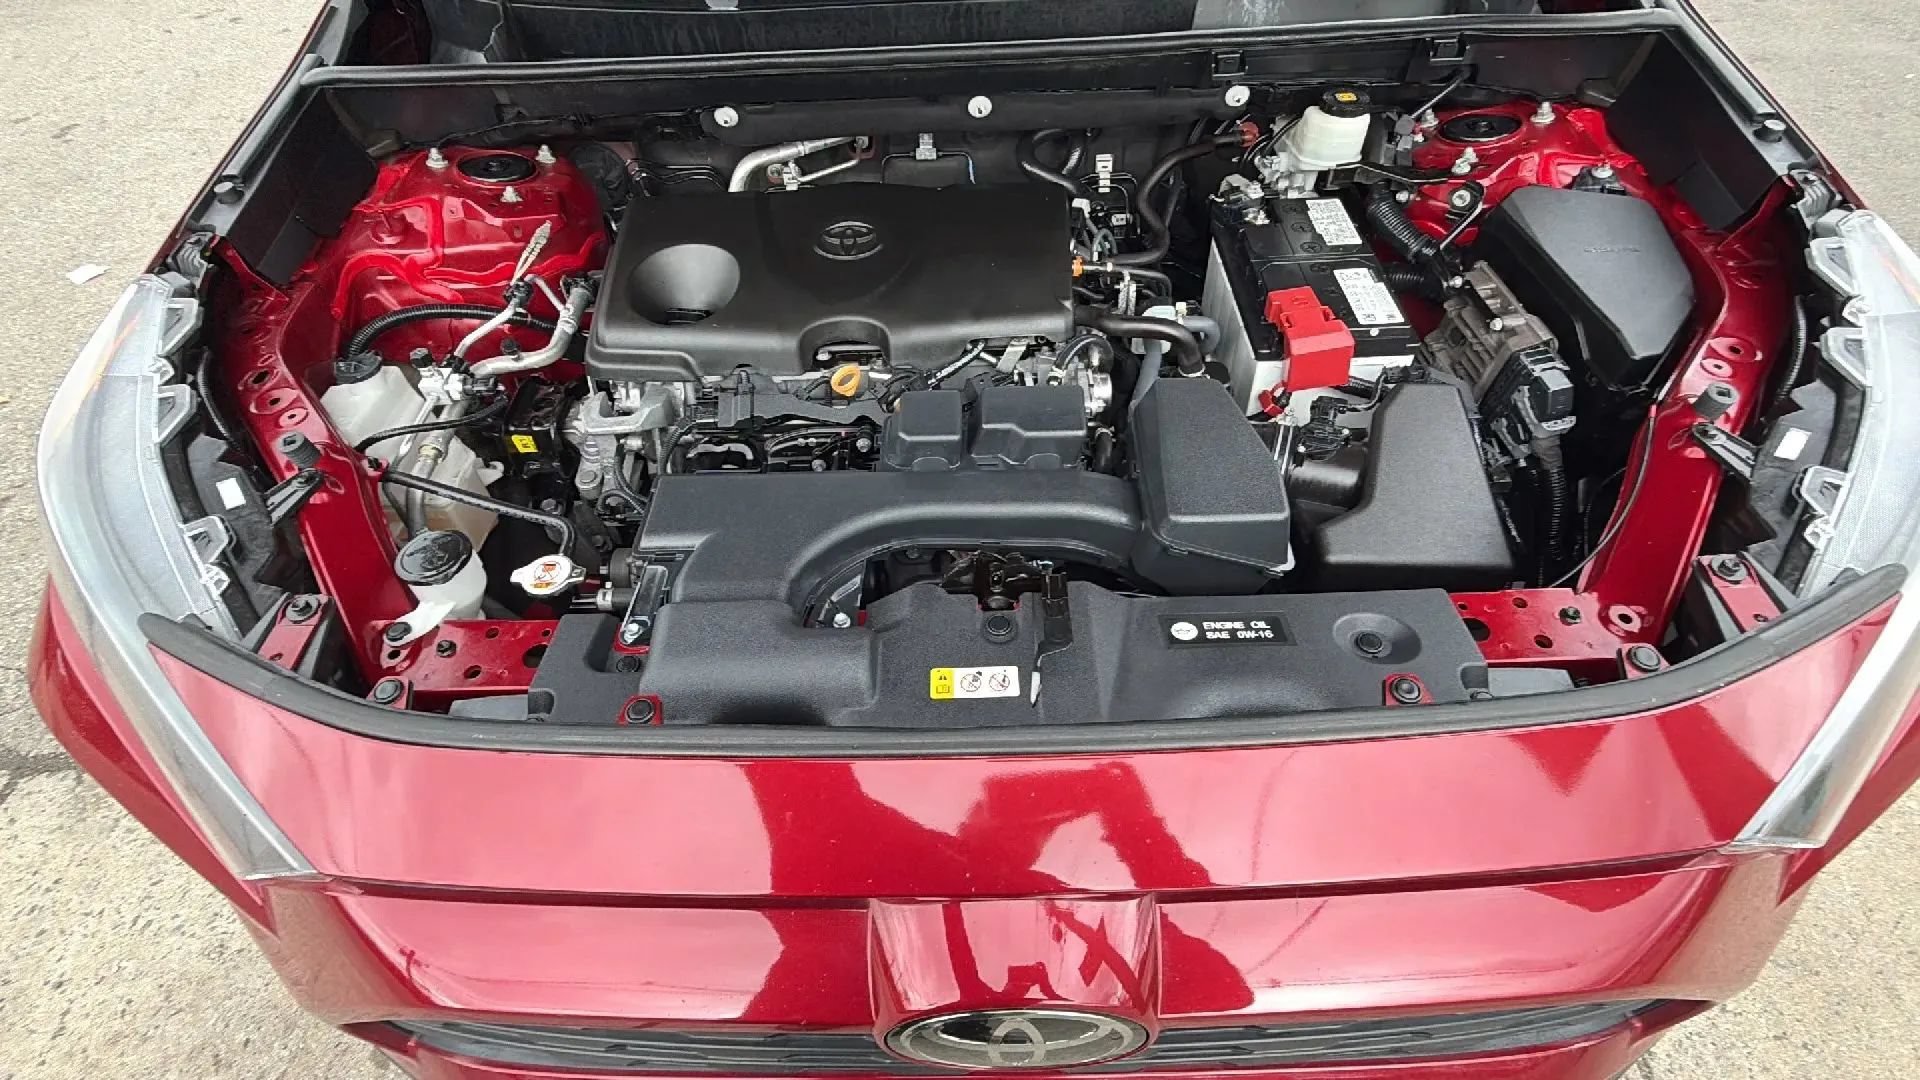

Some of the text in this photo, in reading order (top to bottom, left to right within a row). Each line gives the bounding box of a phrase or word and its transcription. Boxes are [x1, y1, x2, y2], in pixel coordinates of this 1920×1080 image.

[1202, 620, 1271, 629] ENGINE OIL
[1205, 629, 1274, 639] SAE 0W-16
